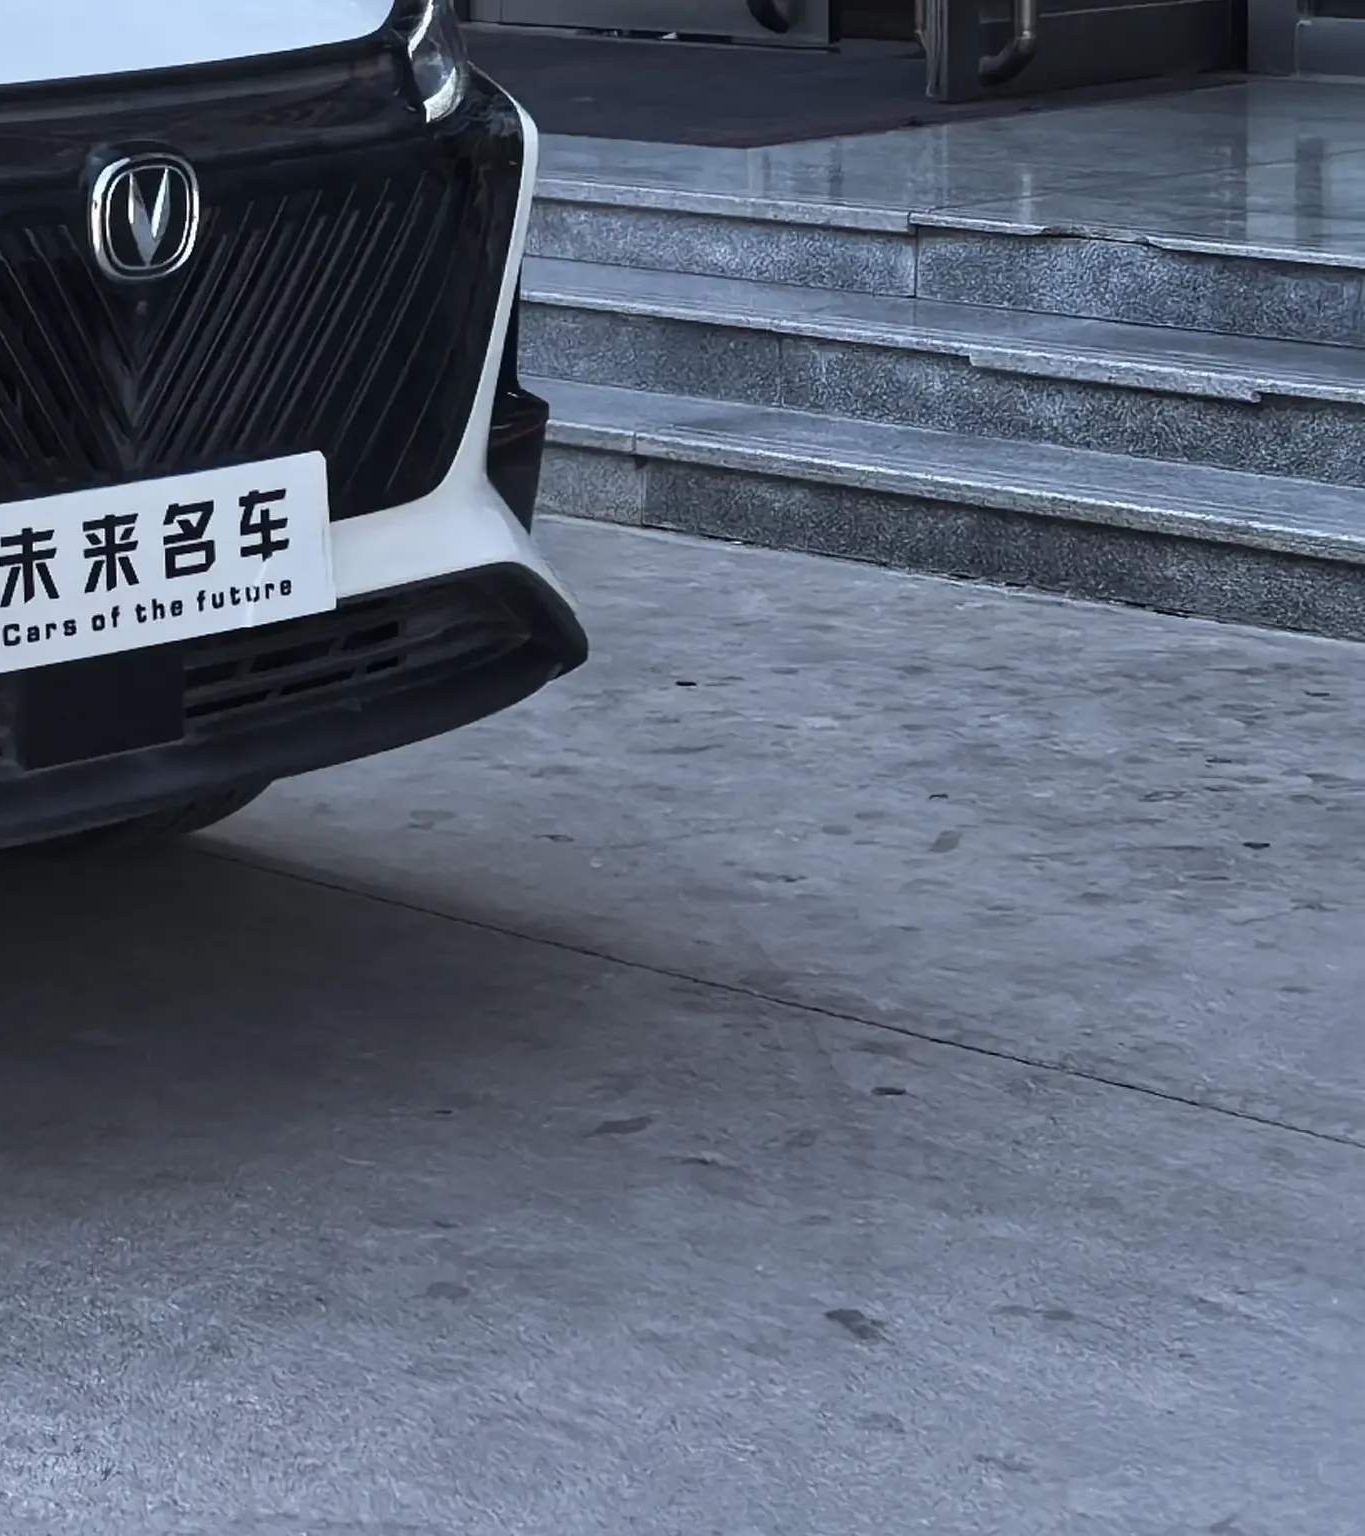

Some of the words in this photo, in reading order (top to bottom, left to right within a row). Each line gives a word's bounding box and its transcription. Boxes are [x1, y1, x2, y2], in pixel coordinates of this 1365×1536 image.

[2, 618, 78, 647] Cars
[91, 606, 120, 632] of
[135, 598, 184, 624] the
[197, 578, 293, 612] future
